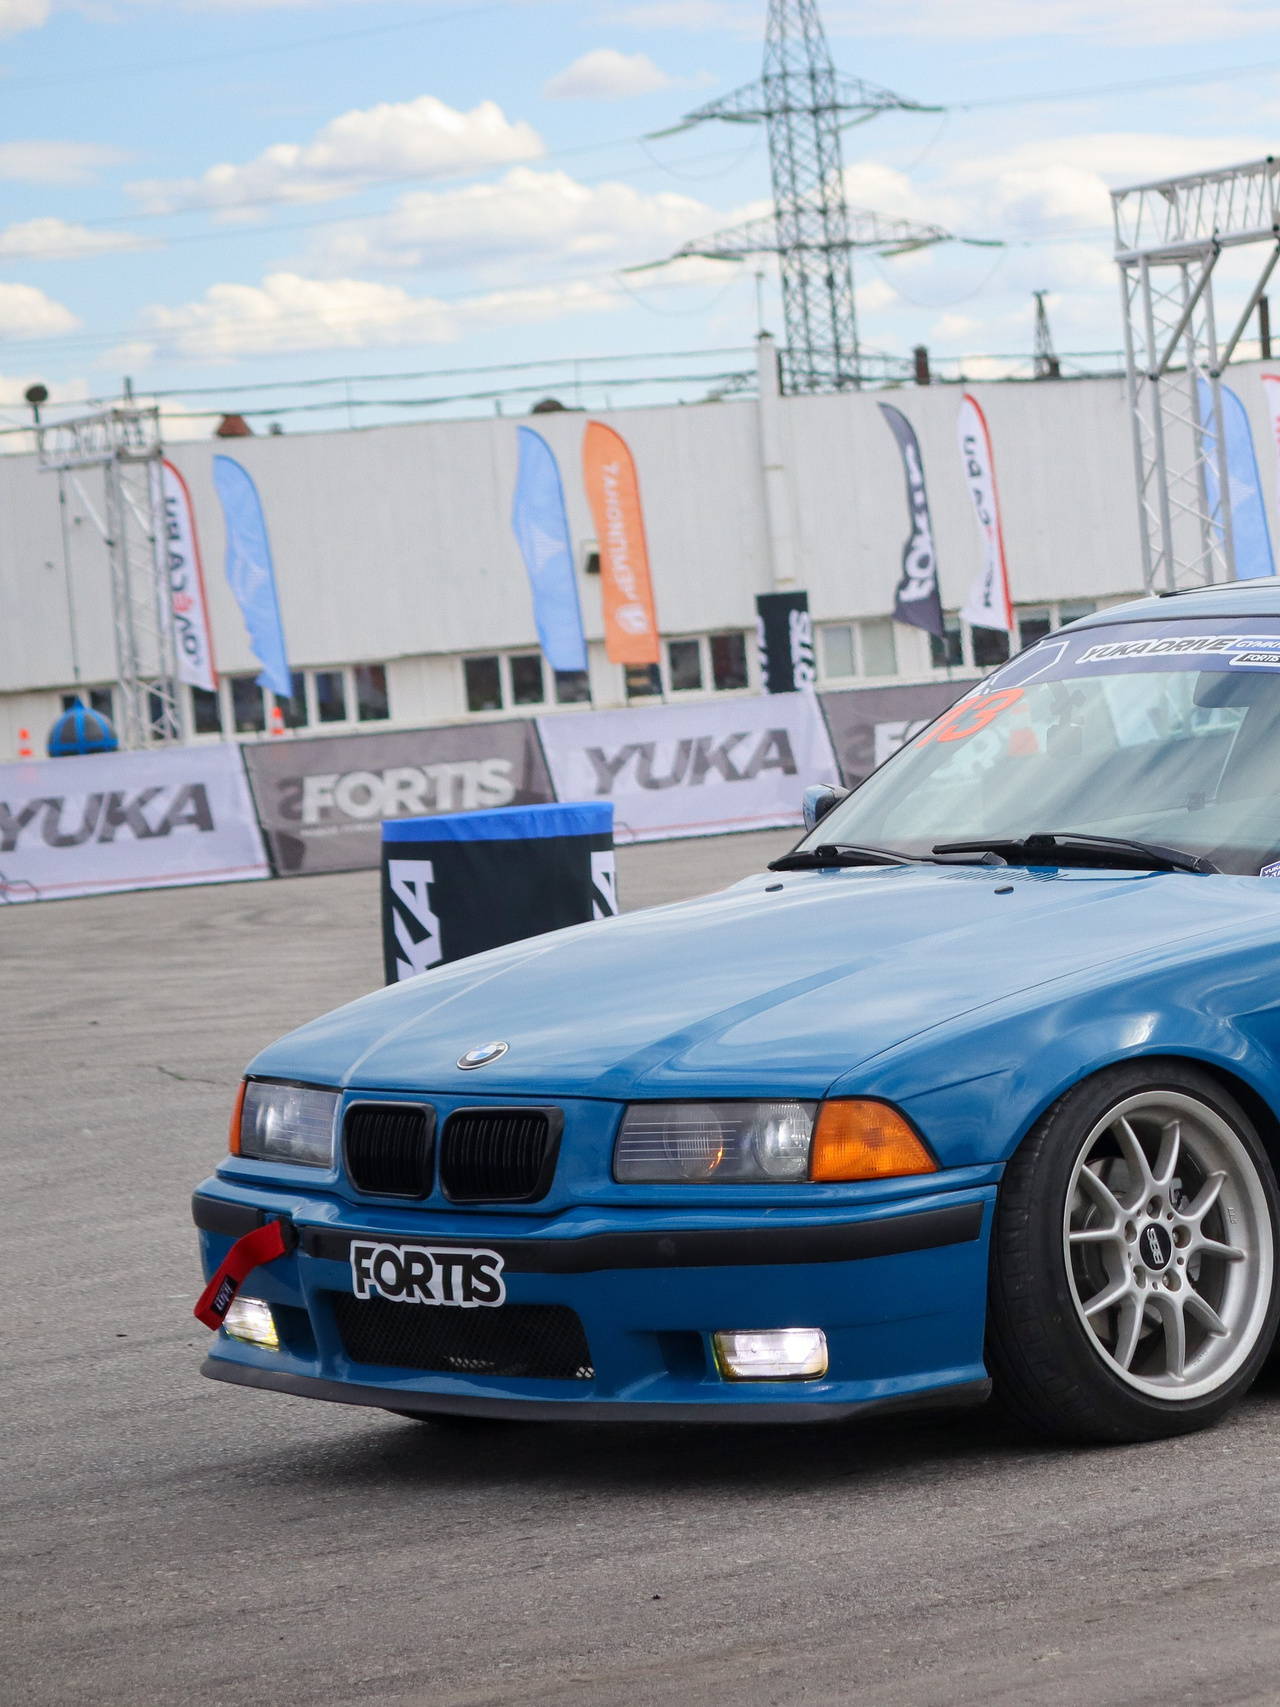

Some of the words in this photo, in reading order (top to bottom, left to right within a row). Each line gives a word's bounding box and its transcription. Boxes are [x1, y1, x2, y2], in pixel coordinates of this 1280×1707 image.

[1082, 640, 1151, 661] YUKA
[1147, 637, 1236, 653] DRIVE
[914, 688, 1025, 748] 13
[302, 758, 517, 825] FORTIS
[585, 728, 798, 796] YUKA
[0, 783, 215, 852] YUKA
[354, 1246, 501, 1303] FORTIS
[1146, 1227, 1165, 1264] BBS
